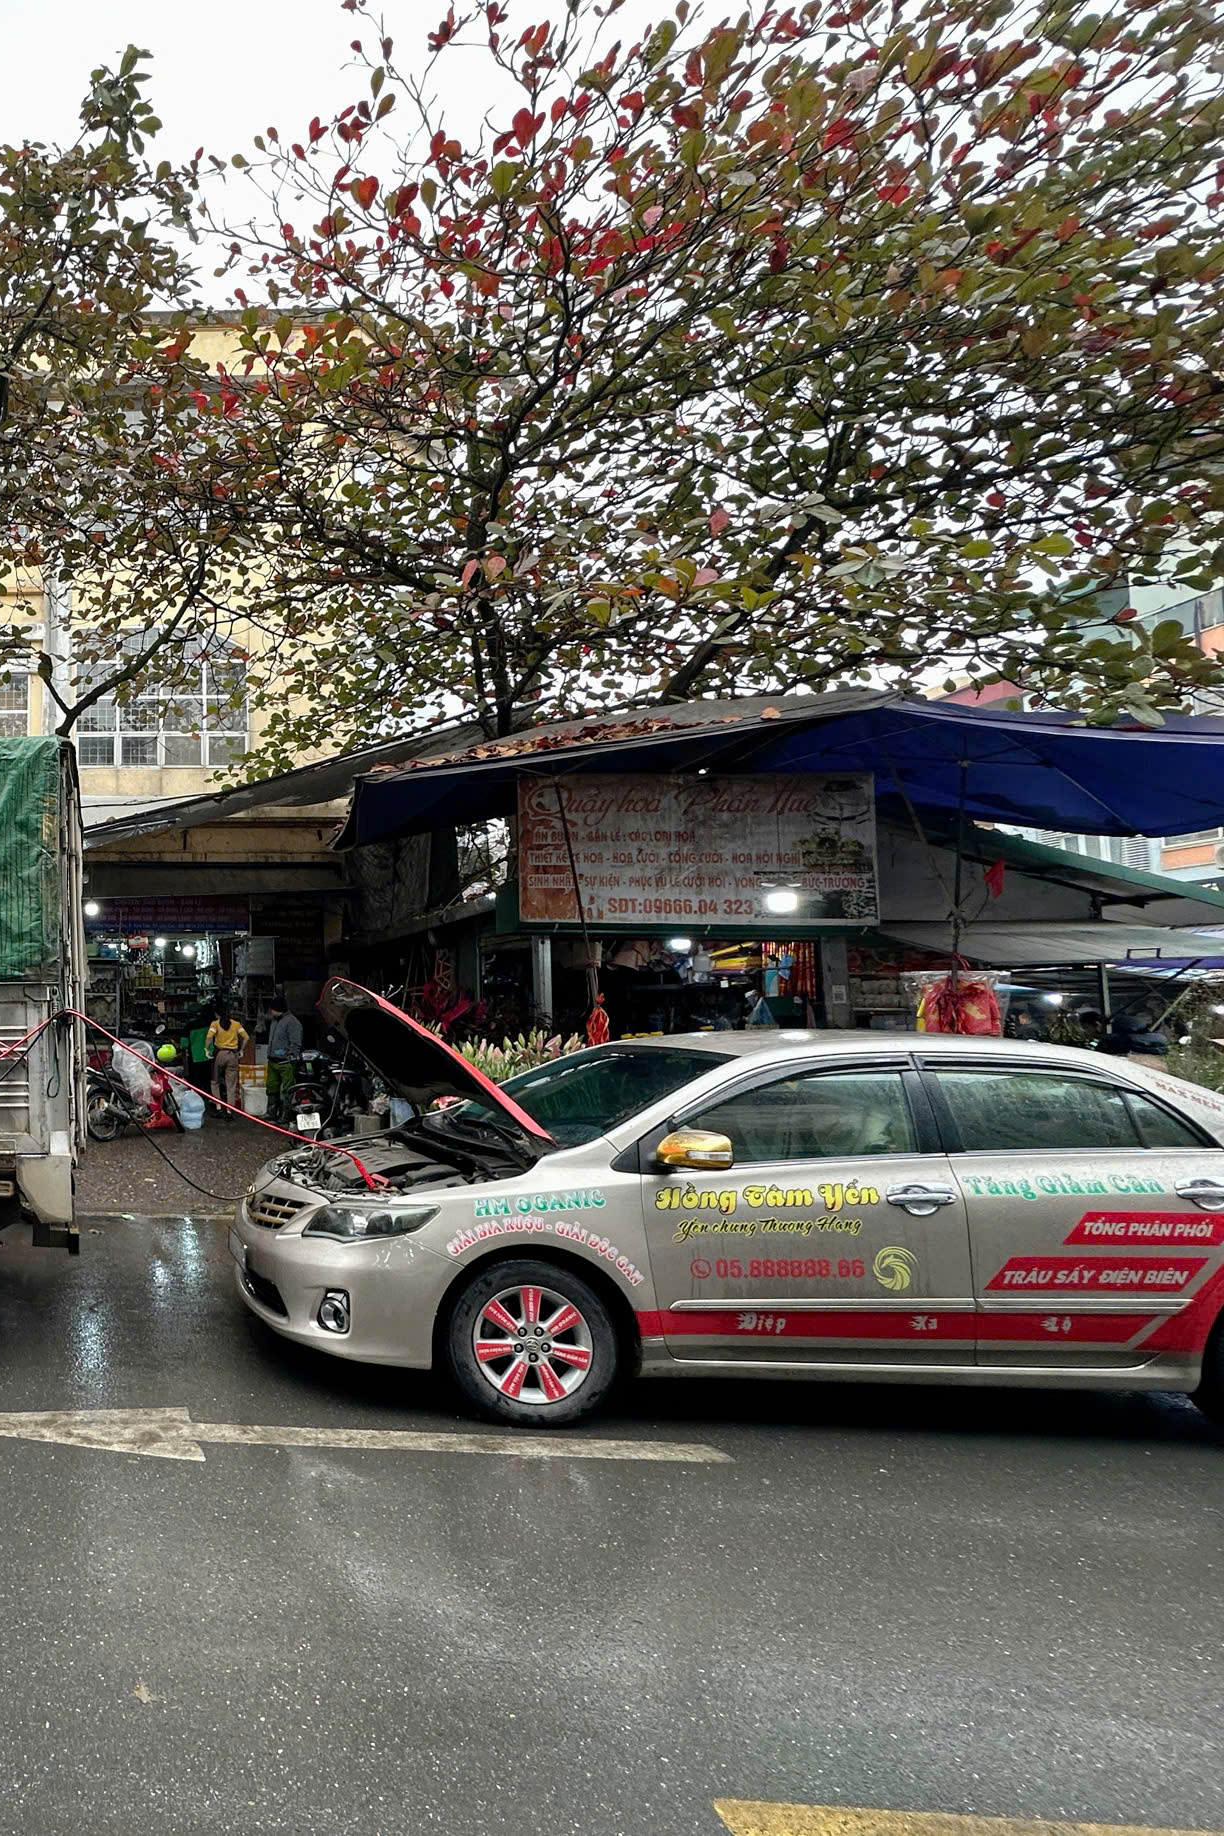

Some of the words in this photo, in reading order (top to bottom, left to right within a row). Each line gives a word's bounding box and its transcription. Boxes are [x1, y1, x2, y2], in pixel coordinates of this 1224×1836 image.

[616, 785, 662, 813] hoa
[584, 853, 603, 863] HOA
[613, 853, 633, 863] HOA
[732, 852, 753, 864] HOA
[529, 877, 550, 887] SINH
[723, 899, 754, 915] 323
[962, 1176, 1038, 1200] Tăng
[1035, 1173, 1108, 1195] Giảm
[1109, 1175, 1166, 1195] Cân
[475, 1197, 512, 1217] HM
[515, 1189, 607, 1214] OGANIC
[655, 1182, 738, 1215] Hồng
[743, 1184, 814, 1207] Tâm
[1083, 1216, 1126, 1237] TỔNG
[1127, 1220, 1173, 1237] PHÂN
[1173, 1219, 1214, 1237] PHỐI
[477, 1220, 504, 1240] BIA
[615, 1255, 645, 1286] GAN
[715, 1258, 866, 1278] 05.888888.66
[1003, 1267, 1053, 1284] TRÂU
[1054, 1264, 1096, 1284] SẤY
[1098, 1267, 1143, 1287] ĐIỆN
[1143, 1267, 1189, 1285] BIÊN
